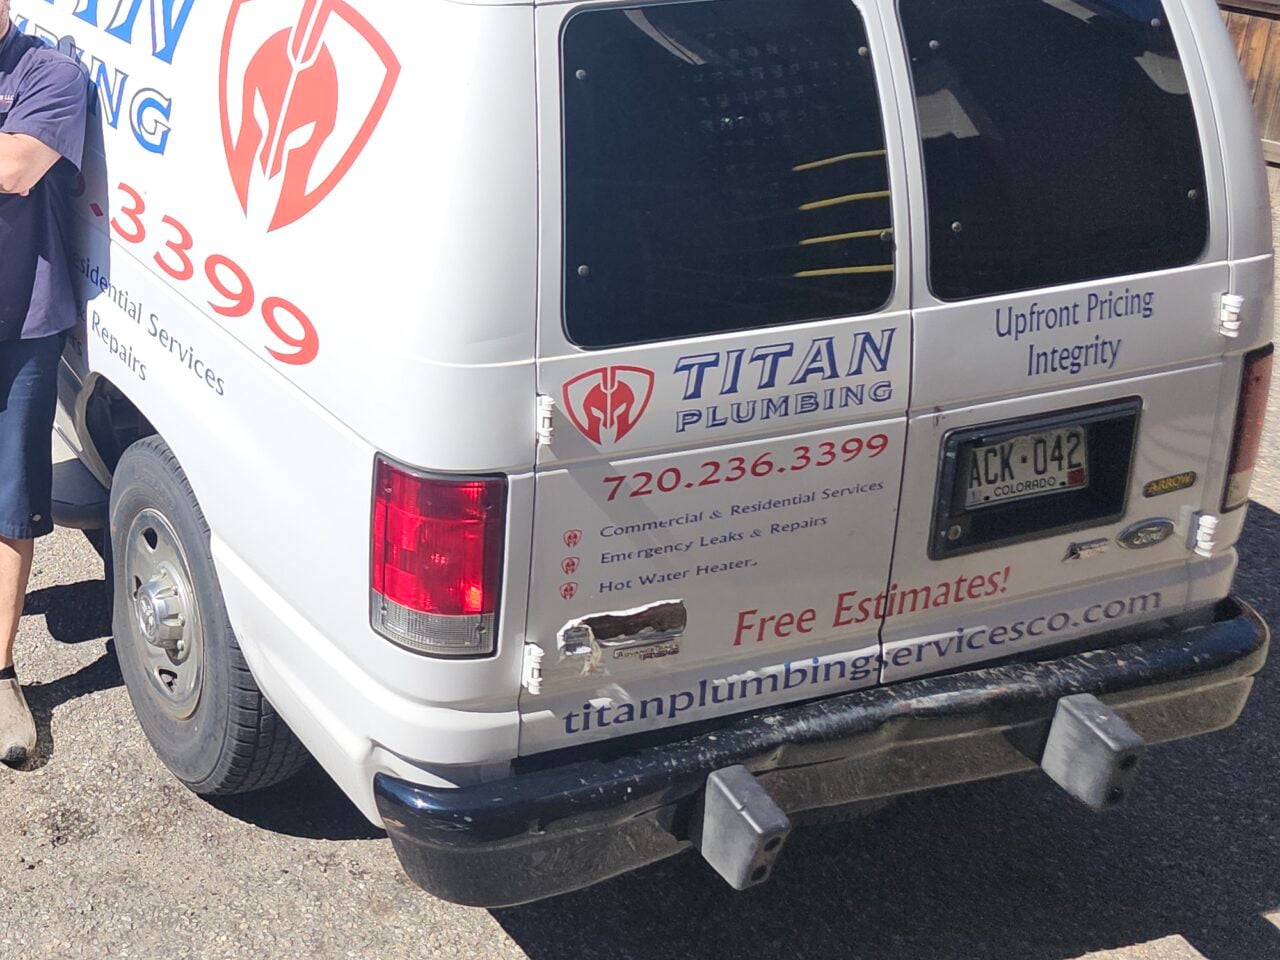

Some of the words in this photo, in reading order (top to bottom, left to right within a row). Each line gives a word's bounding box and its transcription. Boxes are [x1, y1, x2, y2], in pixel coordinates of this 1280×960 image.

[73, 252, 144, 325] esidential
[147, 313, 225, 397] Services
[995, 302, 1080, 341] Upfront
[1086, 288, 1155, 323] Pricing
[91, 309, 148, 382] Repairs
[673, 327, 897, 401] TITAN
[1027, 334, 1122, 377] Integrity
[675, 379, 894, 434] PLUMBING
[602, 433, 889, 502] 720.236.3399
[993, 476, 1056, 497] COLORADO
[600, 511, 704, 538] Commercial
[709, 509, 723, 520] &
[730, 491, 816, 517] Residential
[821, 479, 884, 500] Services
[699, 530, 744, 548] Leaks
[770, 514, 828, 535] Repairs
[599, 580, 632, 593] Hot
[638, 567, 690, 586] Water
[732, 608, 817, 647] Free
[832, 566, 1011, 628] Estimates!
[562, 590, 1162, 735] titanplumbingservicesco.com
